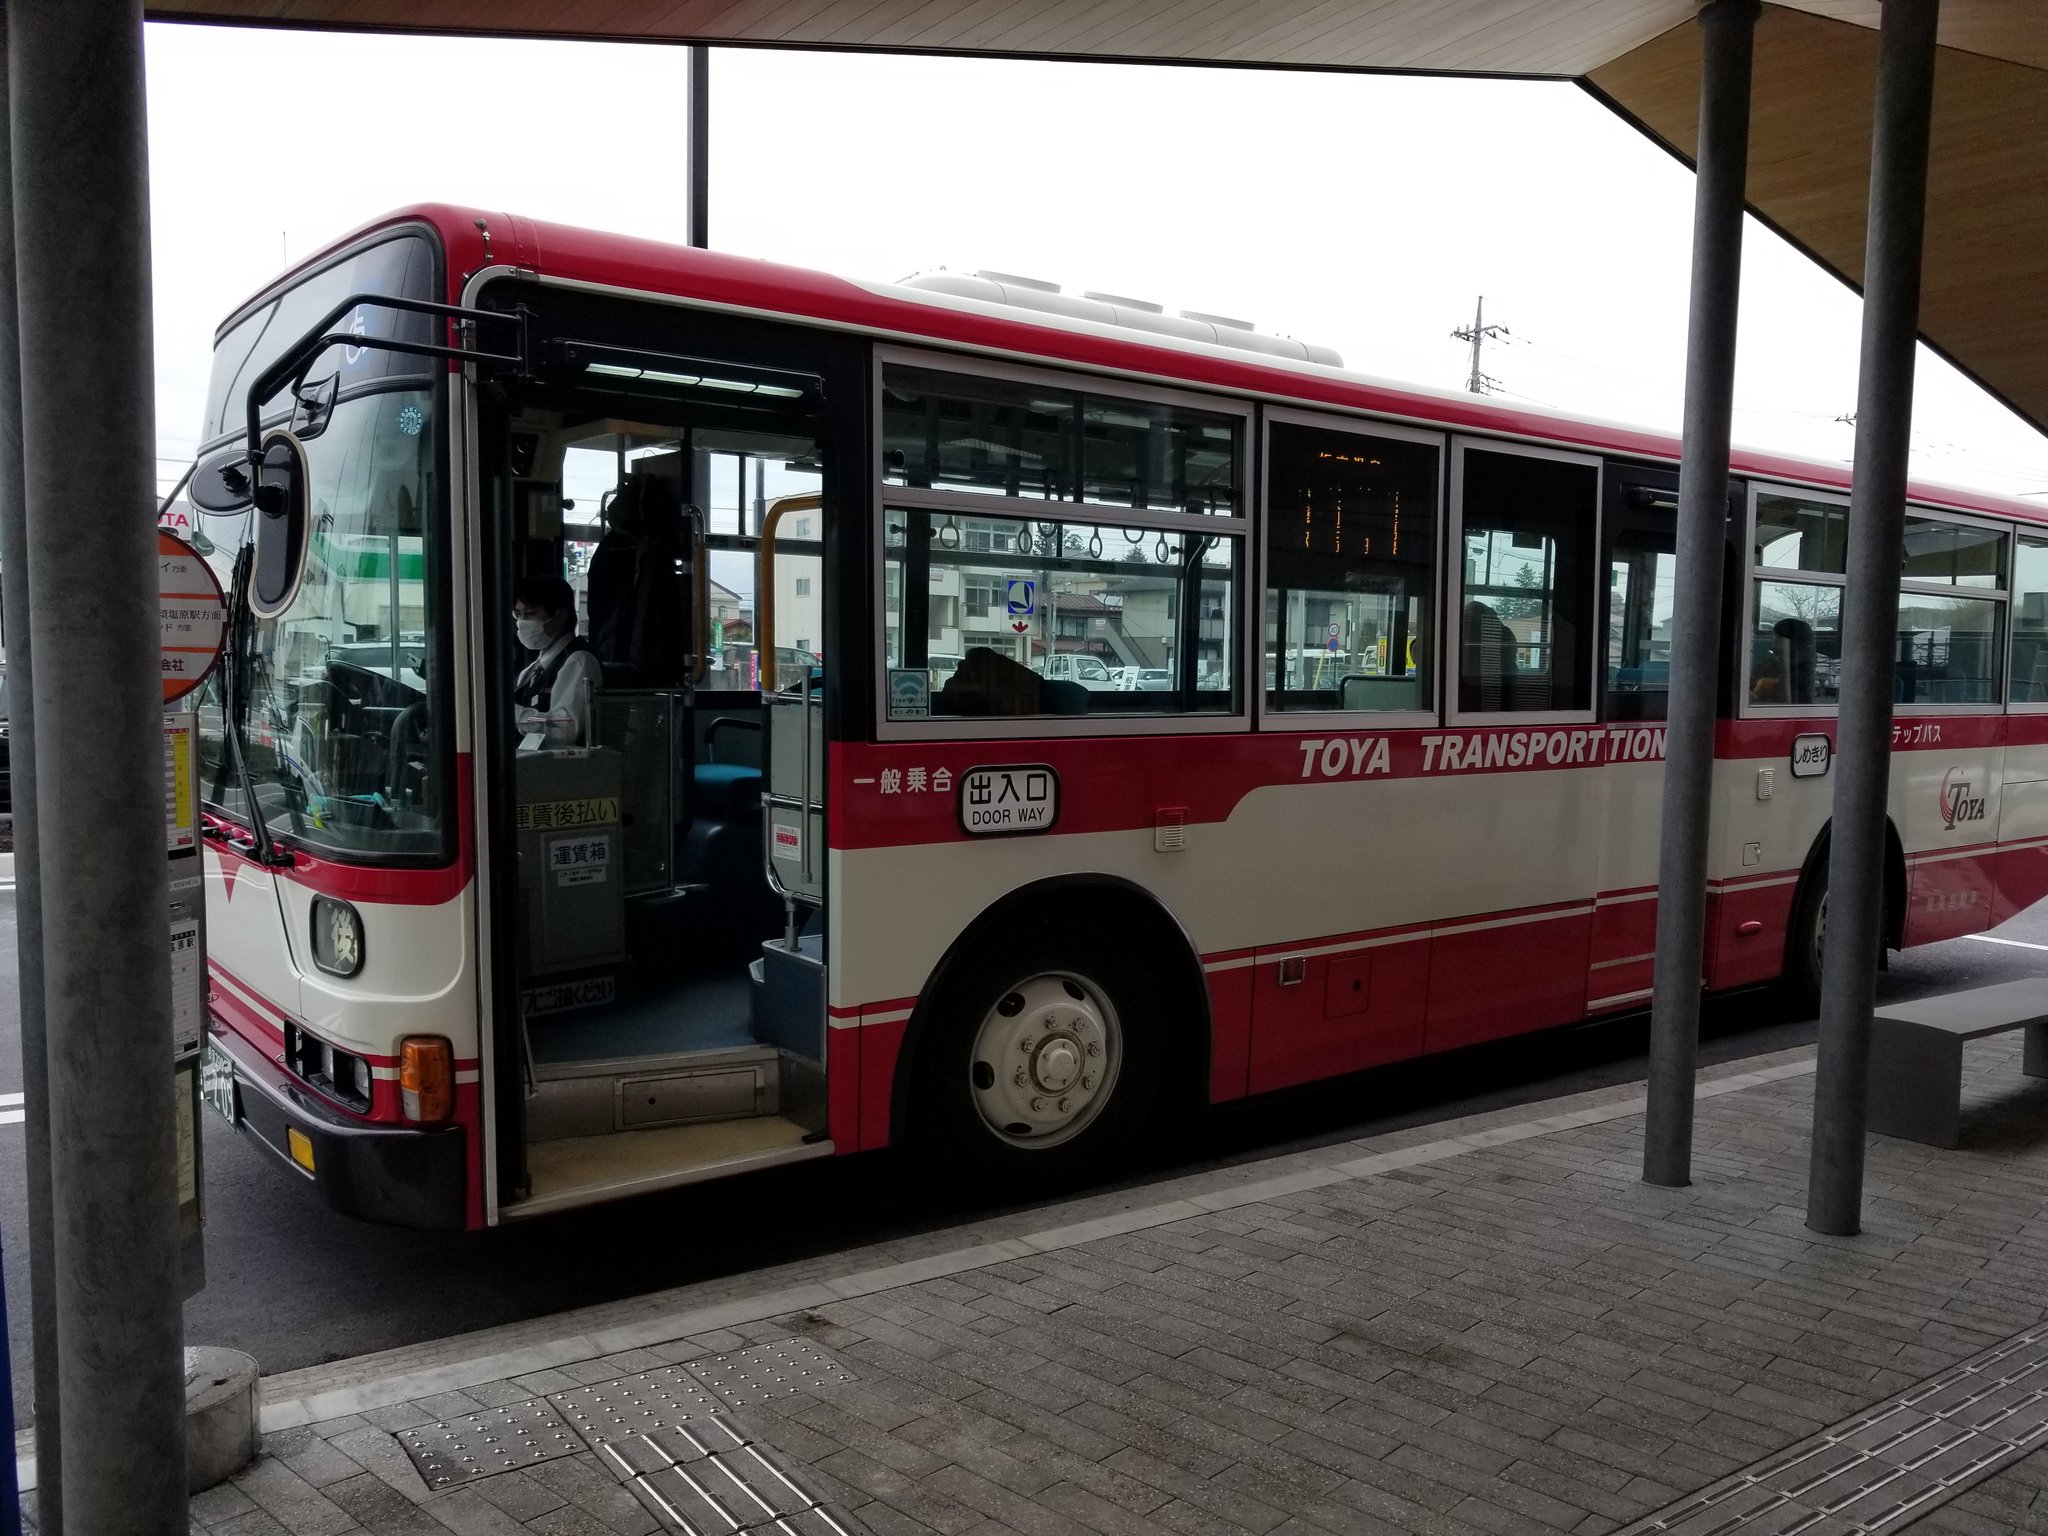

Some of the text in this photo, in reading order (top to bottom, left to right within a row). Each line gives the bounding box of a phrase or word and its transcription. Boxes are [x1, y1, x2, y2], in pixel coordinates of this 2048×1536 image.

[161, 658, 185, 672] 会社
[1893, 724, 1941, 744] テップバス
[1299, 737, 1391, 778] TOYA
[1794, 745, 1828, 764] しめきり
[853, 766, 953, 794] 一般乗合
[970, 773, 1047, 805] 出入口
[972, 806, 1046, 825] DOOR WAY
[554, 842, 606, 865] 運賃箱
